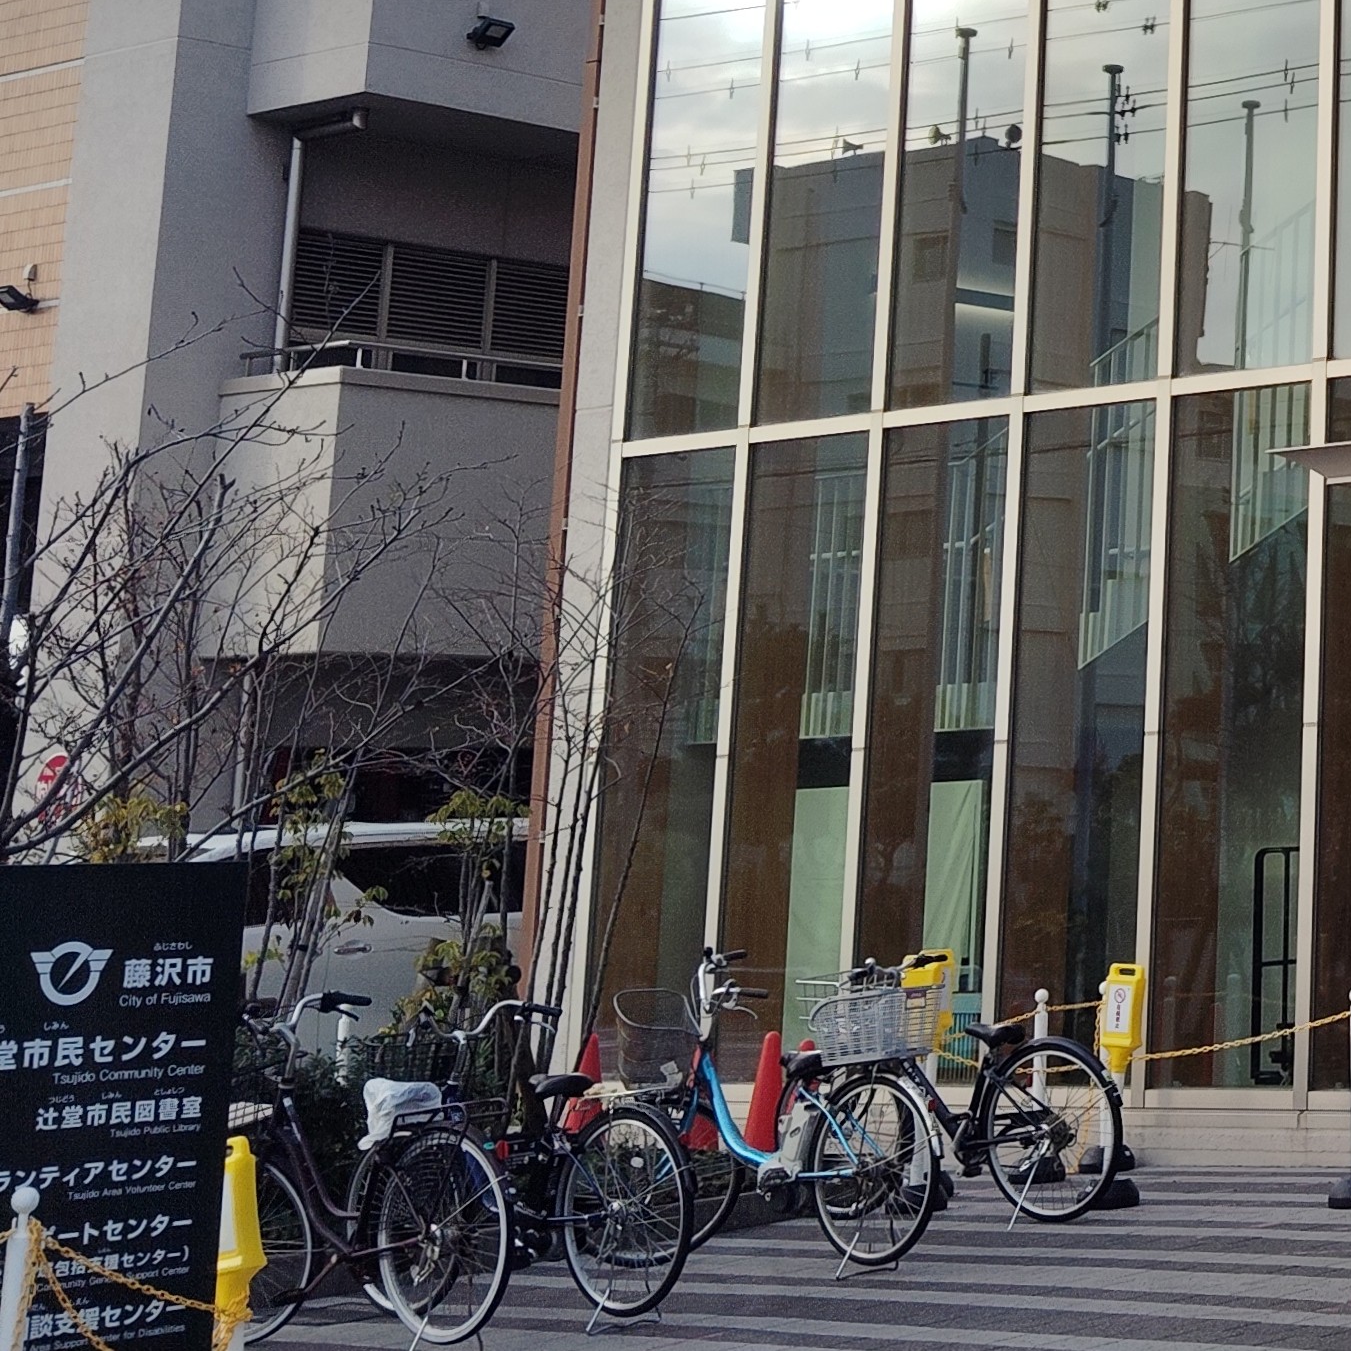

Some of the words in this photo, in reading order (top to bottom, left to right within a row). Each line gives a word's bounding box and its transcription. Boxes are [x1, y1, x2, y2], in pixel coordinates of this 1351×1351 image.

[153, 941, 193, 950] ふじさわし
[123, 956, 214, 988] 藤沢市
[119, 995, 142, 1008] City
[145, 993, 157, 1005] of
[161, 992, 211, 1006] Fujisawa
[44, 1021, 69, 1031] しみん
[0, 1031, 206, 1070] 堂市民センター
[53, 1072, 96, 1086] Tsujido
[100, 1066, 164, 1081] Community
[168, 1064, 206, 1076] Center
[35, 1096, 202, 1132] 辻堂市民図書室
[110, 1128, 141, 1138] Tsujido
[143, 1125, 170, 1135] Public
[173, 1123, 201, 1133] Library
[0, 1155, 197, 1192] ランティアセンター
[68, 1191, 100, 1201] Tsujido
[102, 1188, 122, 1197] Area
[125, 1183, 165, 1195] Volunteer
[169, 1180, 196, 1191] Center
[161, 1265, 190, 1277] Center
[25, 1299, 186, 1342] 談支援センター
[123, 1330, 136, 1339] for
